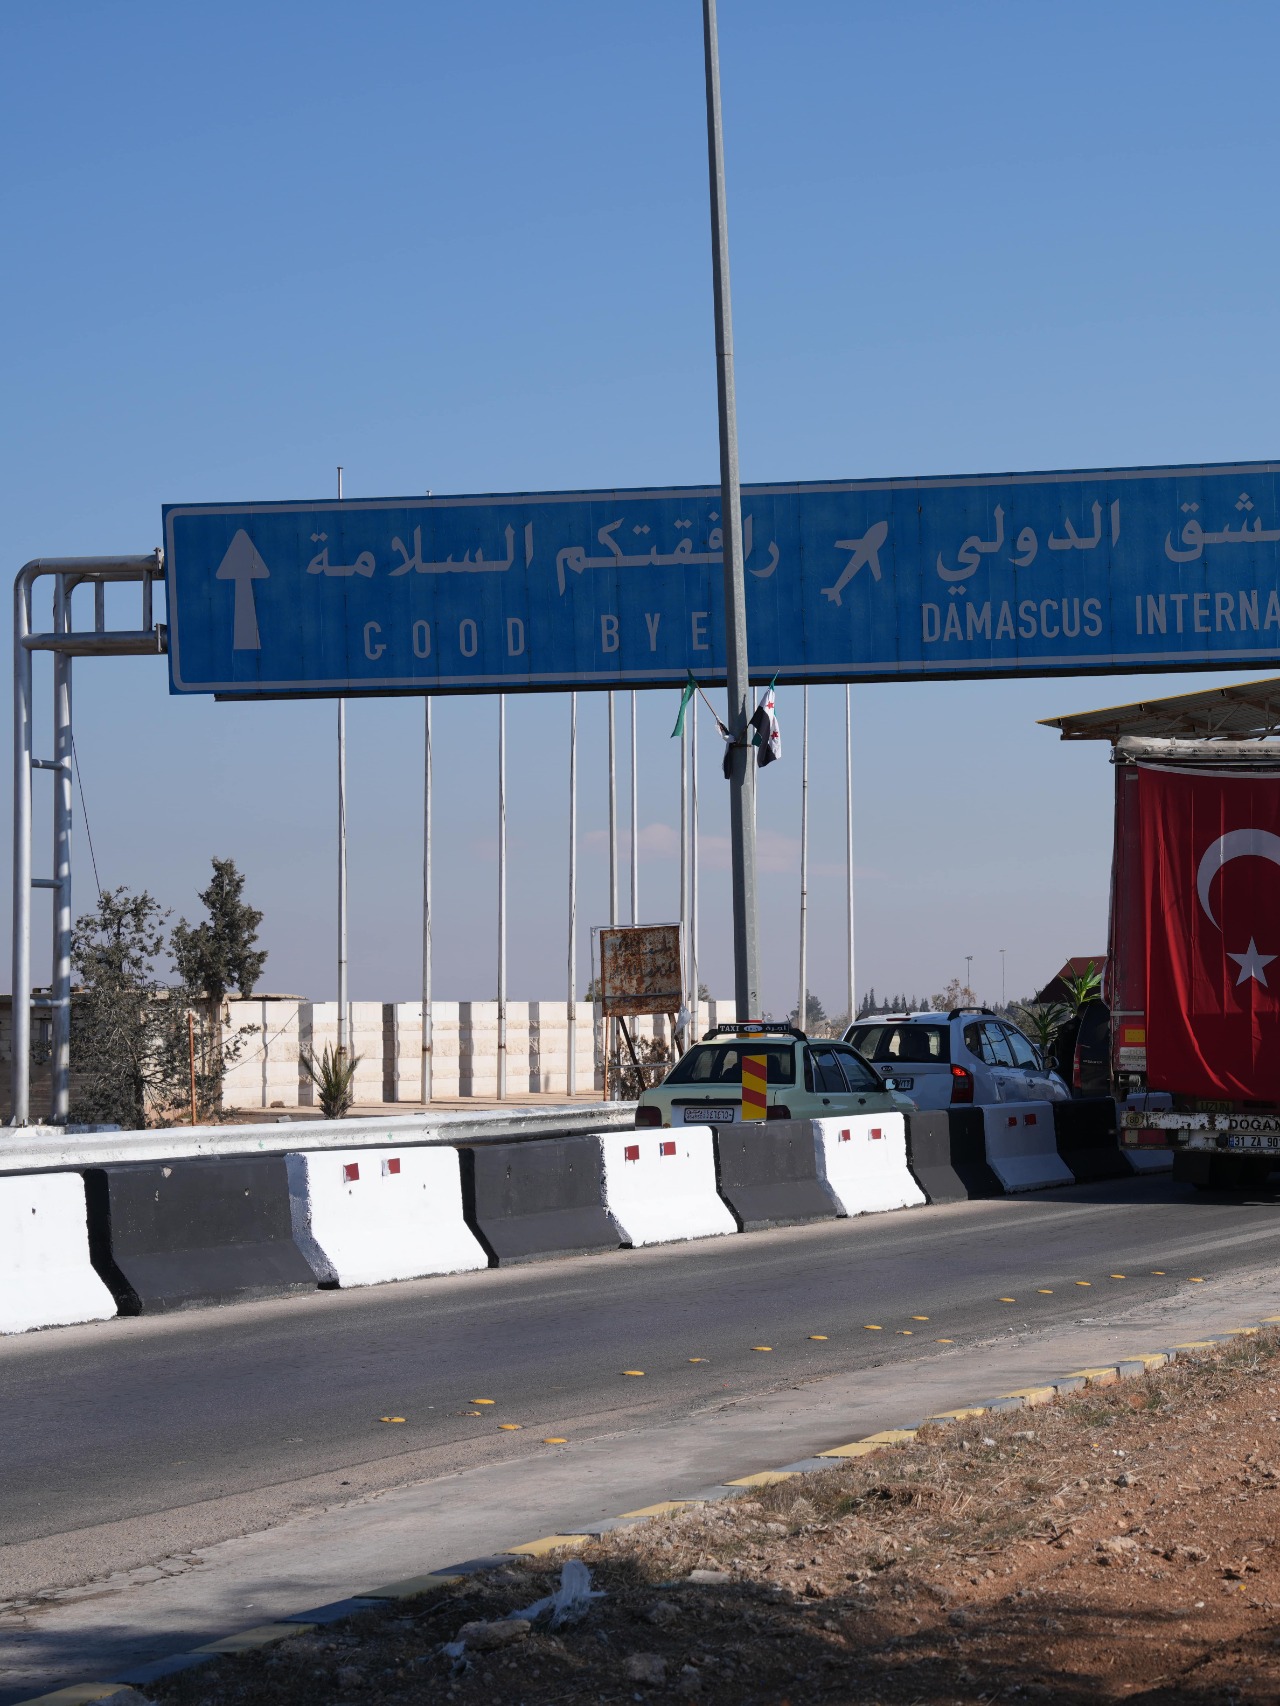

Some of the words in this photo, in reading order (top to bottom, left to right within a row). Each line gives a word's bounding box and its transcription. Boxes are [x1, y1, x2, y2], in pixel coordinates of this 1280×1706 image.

[306, 520, 534, 578] السلامة
[936, 498, 1120, 596] الدولي
[363, 617, 525, 661] GOOD
[601, 611, 709, 653] BYE
[922, 597, 1103, 643] DAMASCUS
[1234, 1136, 1245, 1147] 31
[1251, 1136, 1261, 1147] ZA
